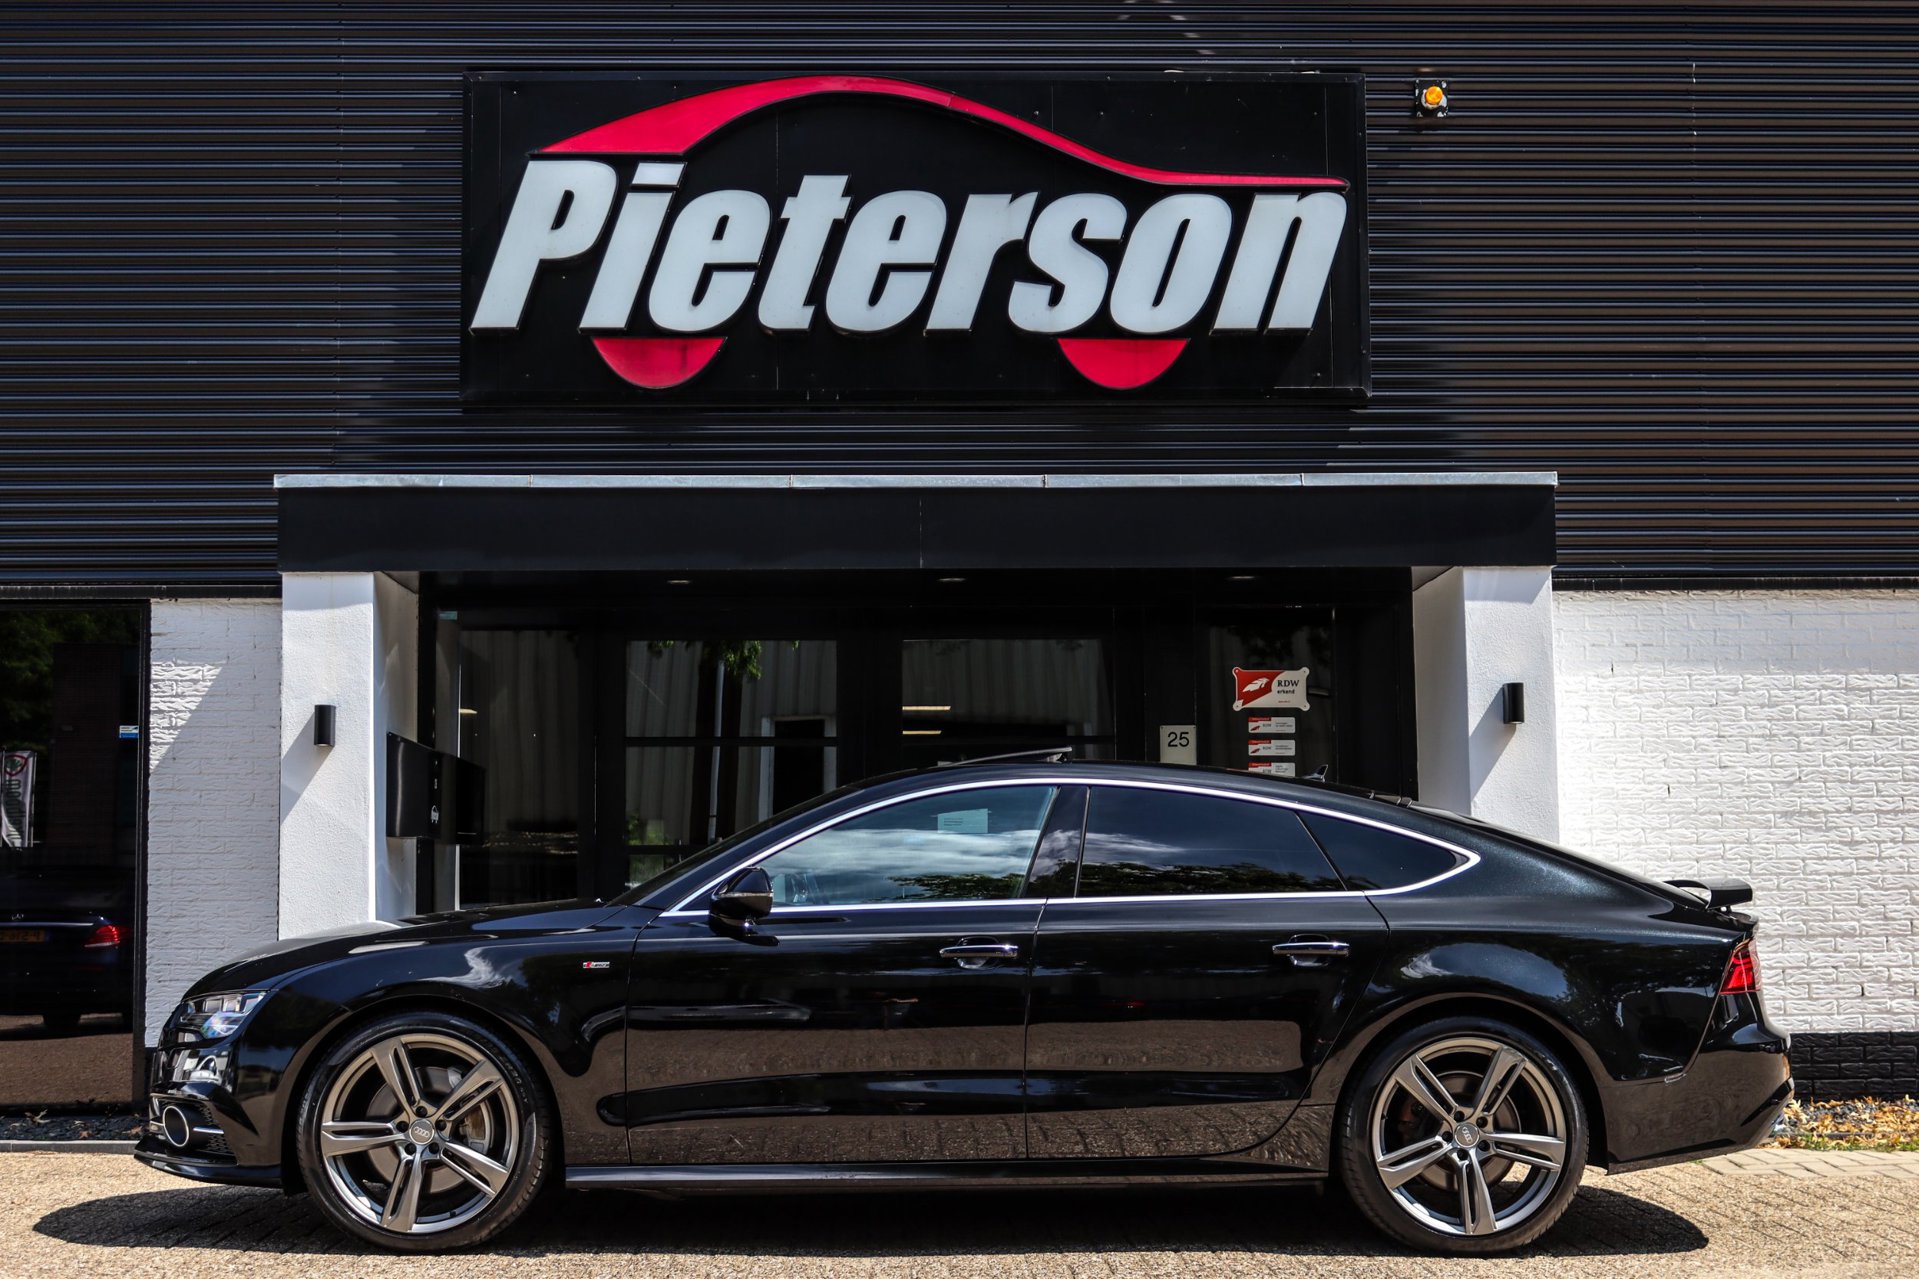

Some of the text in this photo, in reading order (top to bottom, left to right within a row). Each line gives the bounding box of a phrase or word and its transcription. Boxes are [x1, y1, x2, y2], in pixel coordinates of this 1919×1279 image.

[471, 160, 1348, 334] Pieterson
[1277, 679, 1300, 687] RDW
[1167, 732, 1190, 747] 25
